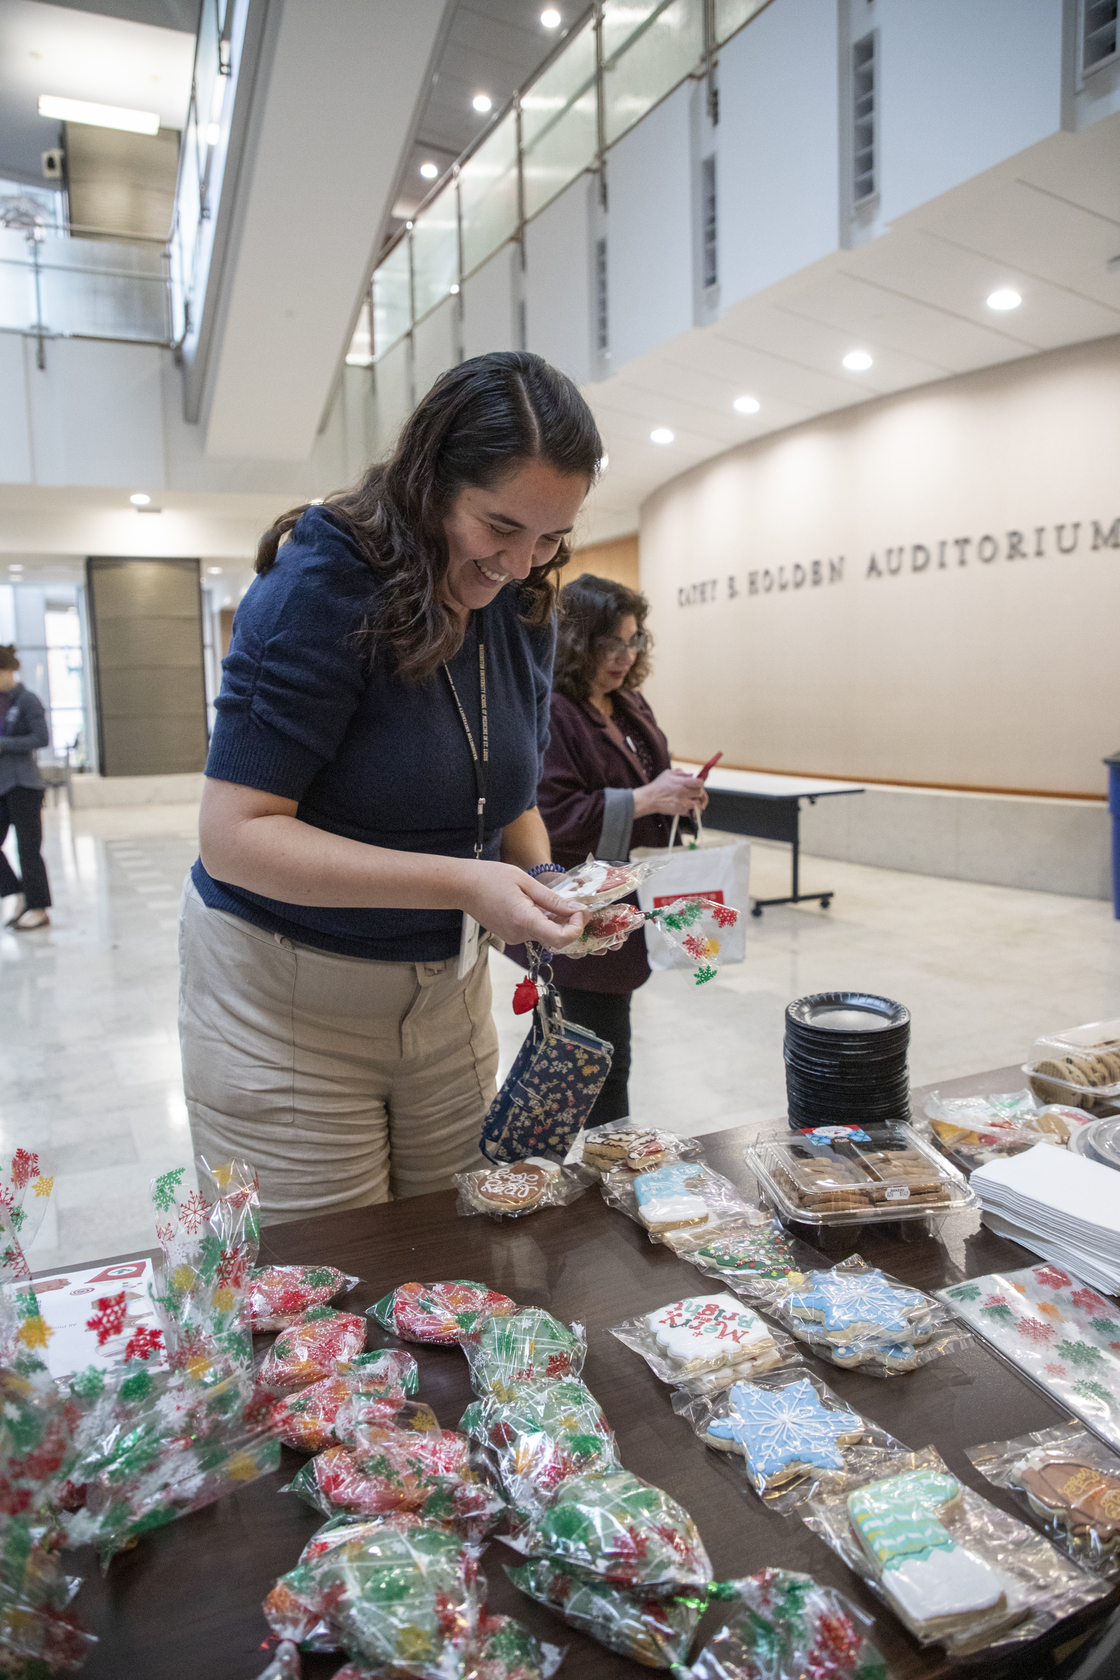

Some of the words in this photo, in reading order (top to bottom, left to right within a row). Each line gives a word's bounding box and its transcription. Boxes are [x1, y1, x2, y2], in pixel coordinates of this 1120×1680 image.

[748, 555, 845, 597] HOLDEN
[866, 517, 1120, 579] AUDITORIUM
[659, 1312, 749, 1344] Merry
[674, 1300, 760, 1329] Bright
[693, 1315, 713, 1323] and
